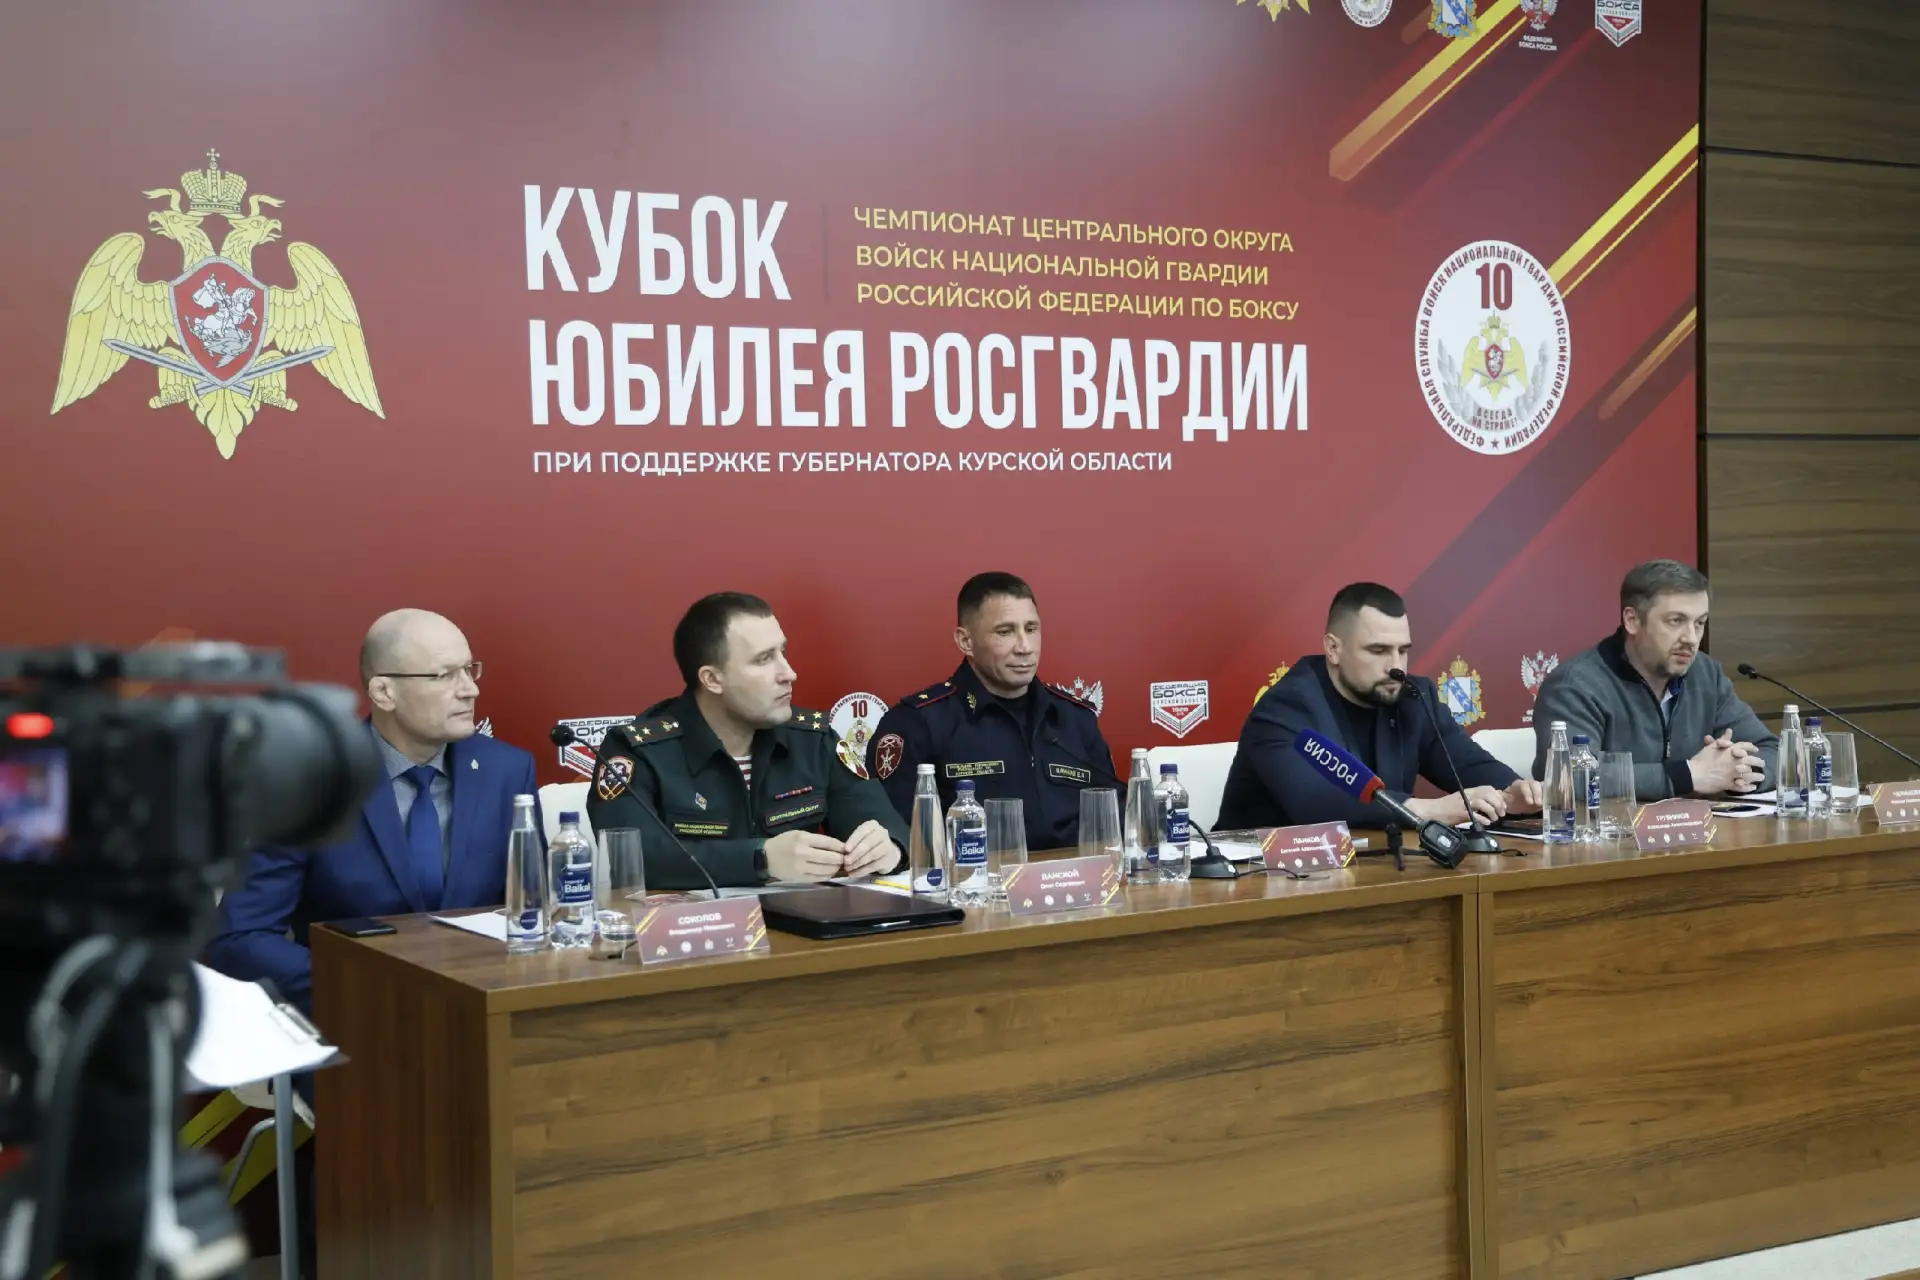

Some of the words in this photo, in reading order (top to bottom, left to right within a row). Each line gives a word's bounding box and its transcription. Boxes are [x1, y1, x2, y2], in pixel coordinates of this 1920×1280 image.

[524, 184, 792, 300] КУБОК
[854, 206, 1016, 237] ЧЕМПИОНАТ
[1022, 216, 1208, 249] ЦЕНТРАЛЬНОГО
[1213, 229, 1294, 252] ОКРУГА
[856, 242, 945, 270] ВОЙСК
[952, 251, 1160, 281] НАЦИОНАЛЬНОЙ
[1166, 262, 1269, 287] ГВАРДИИ
[1446, 245, 1524, 279] НАЦИОНАЛЬНОЙ
[1522, 257, 1560, 308] ГВАРДИИ
[857, 282, 1032, 311] РОССИЙСКОЙ
[1038, 290, 1185, 319] ФЕДЕРАЦИИ
[1191, 299, 1223, 318] ПО
[1229, 299, 1299, 321] БОКСУ
[1422, 274, 1447, 317] ВОЙСК
[1475, 262, 1513, 311] 10
[1418, 319, 1431, 377] СЛУЖБА
[1550, 309, 1568, 400] РОССИЙСКОЙ
[529, 319, 867, 427] ЮБИЛЕЯ
[889, 330, 1308, 442] РОСГВАРДИИ
[1424, 379, 1485, 448] ФЕДЕРАЛЬНАЯ
[1504, 398, 1556, 449] ФЕДЕРАЦИИ
[533, 451, 592, 474] ПРИ
[601, 451, 771, 477] ПОДДЕРЖКЕ
[778, 451, 952, 473] ГУБЕРНАТОРА
[958, 447, 1065, 472] КУРСКОЙ
[1070, 451, 1173, 472] ОБЛАСТИ
[850, 700, 868, 718] 10
[1153, 688, 1207, 699] БОКСА
[1303, 738, 1358, 785] РОССИЯ
[961, 846, 985, 855] Baikal
[564, 882, 591, 894] Baikal
[678, 912, 723, 925] СОКОЛОВ
